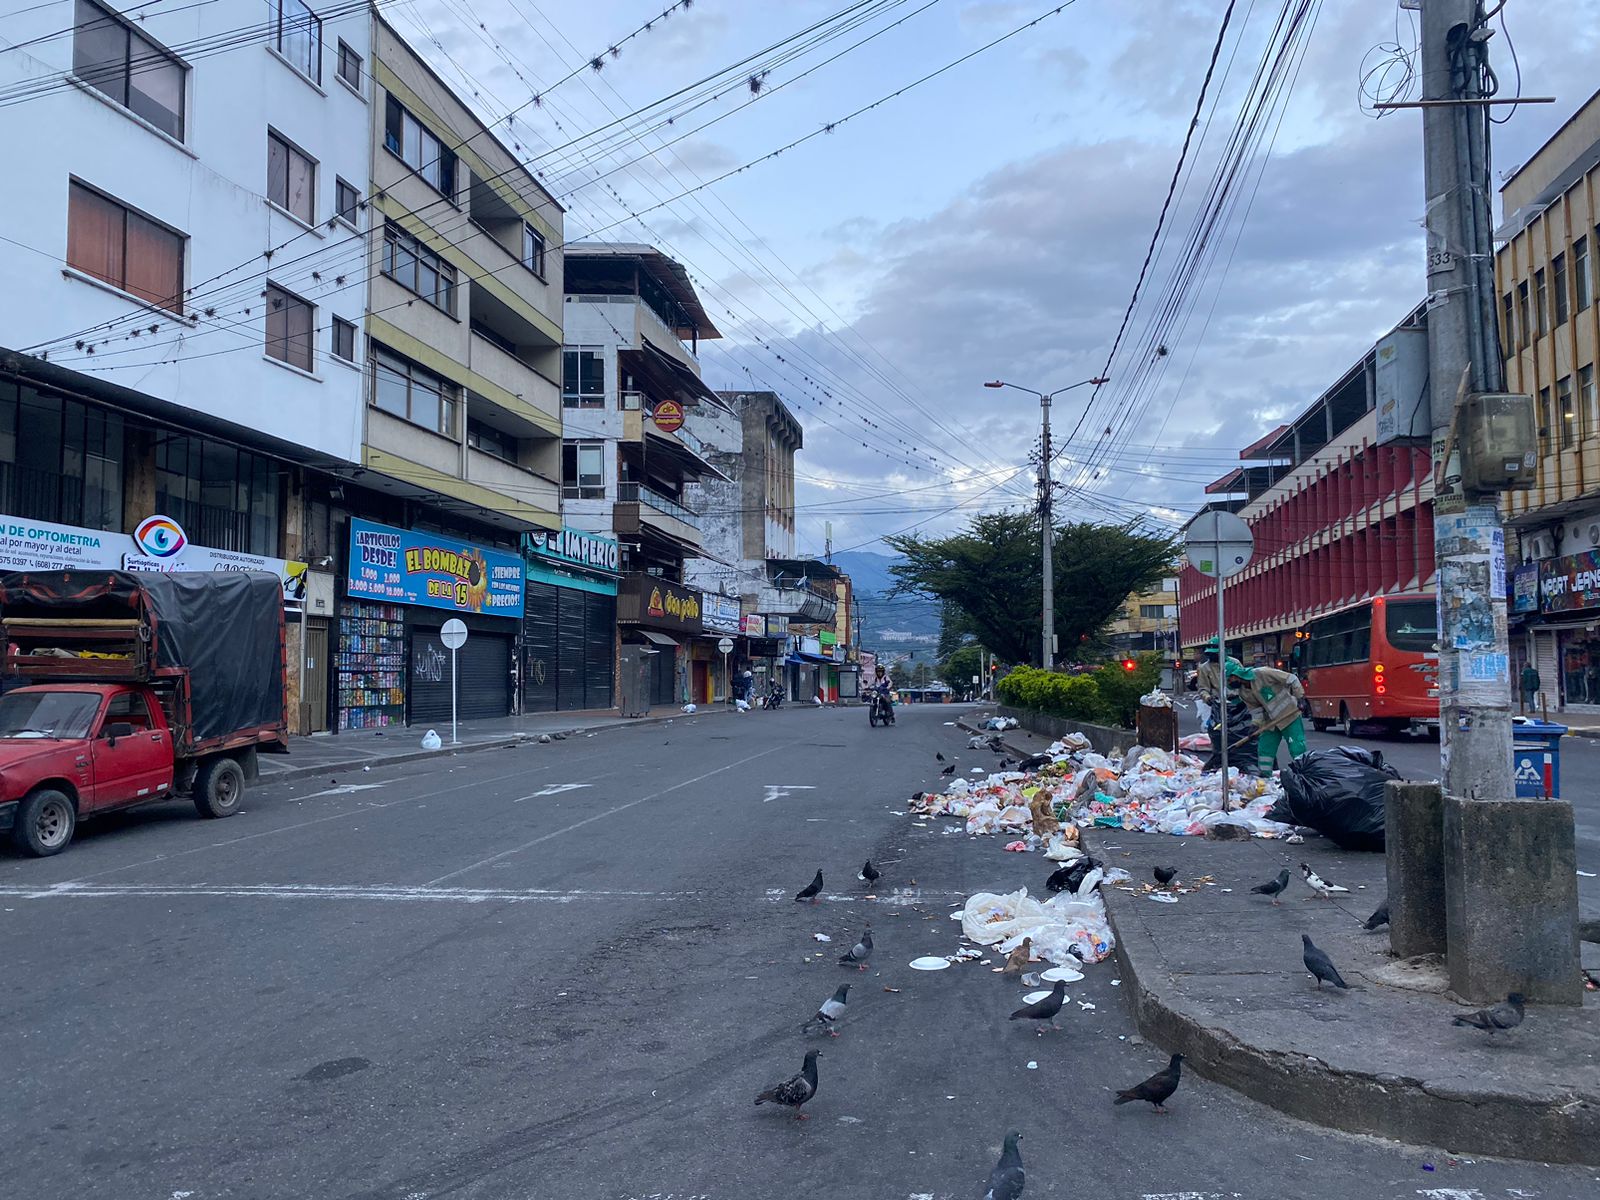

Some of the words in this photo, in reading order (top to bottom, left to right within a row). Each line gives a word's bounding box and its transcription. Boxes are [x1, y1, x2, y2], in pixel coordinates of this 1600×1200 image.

[9, 525, 25, 537] DE
[28, 528, 101, 548] OPTOMETRIA
[9, 539, 22, 549] por
[24, 541, 48, 552] mayor
[49, 545, 54, 554] y
[63, 546, 82, 555] detal
[209, 551, 240, 561] DISTRIBUIDOR
[239, 556, 265, 565] AUTORIZADO
[362, 545, 397, 568] DESDE!
[405, 549, 421, 573] EL
[565, 530, 617, 570] IMPERIO
[361, 567, 378, 580] 1.000
[384, 573, 400, 583] 2.000
[428, 580, 440, 596] DE
[441, 583, 452, 597] LA
[455, 582, 468, 605] 15
[492, 594, 520, 607] PRECIOS!
